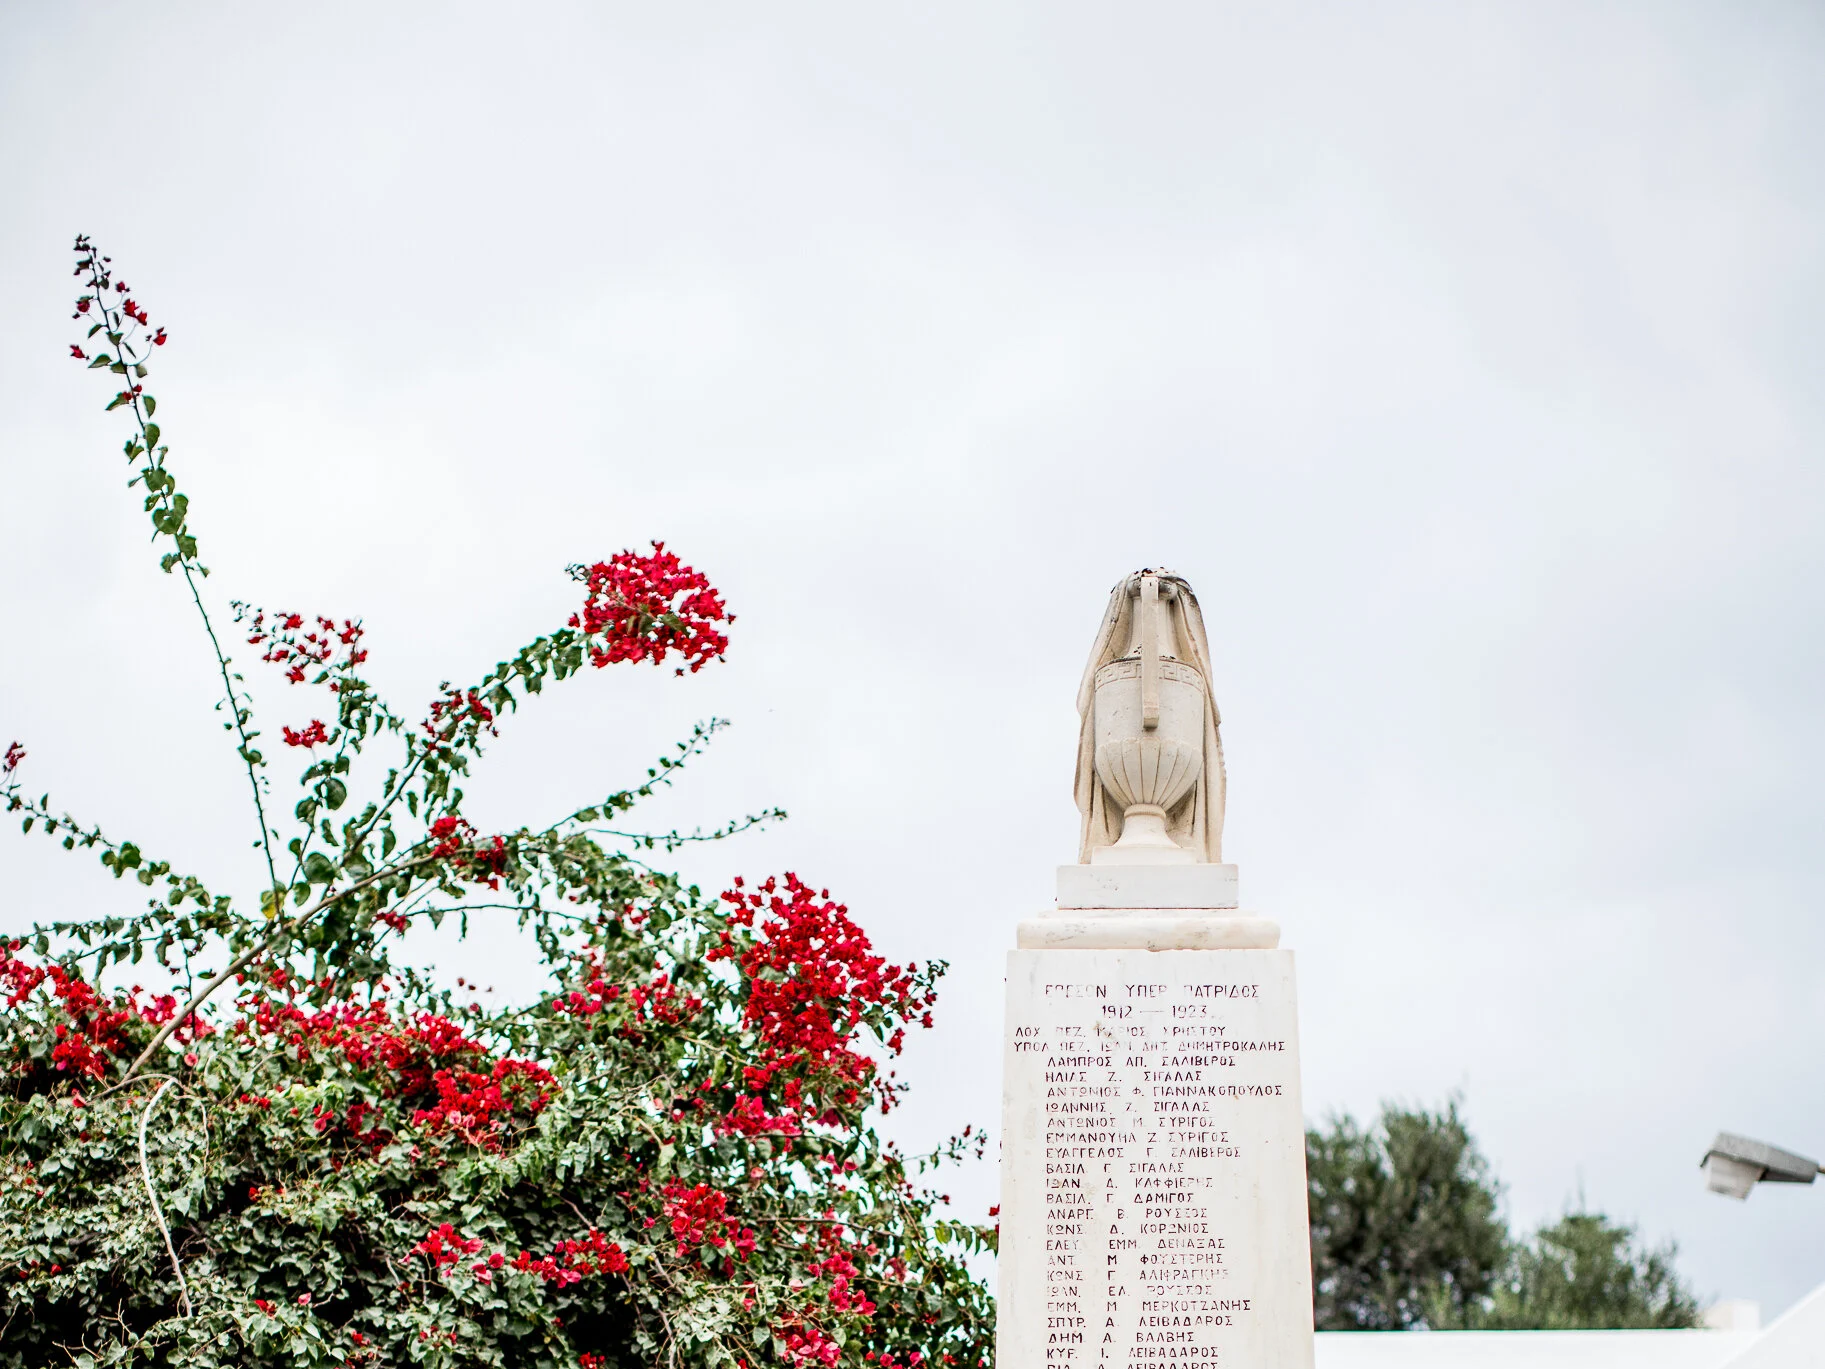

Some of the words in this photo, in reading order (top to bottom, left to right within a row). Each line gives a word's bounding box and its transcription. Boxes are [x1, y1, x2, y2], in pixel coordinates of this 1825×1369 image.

[1125, 985, 1167, 998] ΥΠΕΡ
[1184, 985, 1259, 998] ΠΑΤΡΙΔΟΣ
[1102, 1005, 1132, 1019] 1912
[1179, 1041, 1285, 1051] ΔΗΜΗΤΡΟΚΑΛΗΣ
[1048, 1056, 1112, 1067] ΛΑΜΠΡΟΣ
[1126, 1056, 1147, 1067] ΑΠ.
[1162, 1056, 1235, 1067] ΣΑΛΙΒΕΡΟΣ
[1046, 1072, 1086, 1082] ΗΛΙΑΣ
[1108, 1072, 1122, 1082] Ζ.
[1144, 1071, 1201, 1082] ΣΙΓΑΛΑΣ
[1048, 1087, 1120, 1097] ΑΝΤΩΝΙΟΣ
[1132, 1086, 1144, 1097] Φ.
[1154, 1085, 1282, 1097] ΓΙΑΝΝΑΚΟΠΟΥΛΟΣ
[1126, 1103, 1137, 1111] Ζ.
[1154, 1101, 1209, 1112] ΣΙΓΑΛΑΣ
[1048, 1118, 1115, 1128] ΑΝΤΩΝΙΟΣ
[1159, 1117, 1215, 1127] ΣΥΡΙΓΟΣ
[1047, 1132, 1136, 1144] ΕΜΜΑΝΟΥΗΛ
[1169, 1132, 1228, 1143] ΣΥΡΙΓΟΣ
[1047, 1148, 1124, 1158] ΕΥΑΓΓΕΛΟΣ
[1172, 1147, 1240, 1158] ΣΑΛΙΒΕΡΟΣ
[1129, 1163, 1184, 1173] ΣΙΓΑΛΑΣ
[1106, 1178, 1117, 1188] Δ.
[1047, 1193, 1090, 1204] ΒΑΣΙΛ.
[1134, 1193, 1194, 1203] ΔΑΜΙΓΟΣ
[1146, 1208, 1207, 1218] ΡΟΥΣΣΟΣ
[1110, 1224, 1124, 1235] Δ.
[1141, 1223, 1208, 1234] ΚΟΡΩΝΙΟΣ
[1158, 1239, 1225, 1249] ΔΕΝΑΞΑΣ
[1140, 1254, 1222, 1264] ΦΟΥΣΤΕΡΗΣ
[1048, 1302, 1080, 1313] ΕΜΜ.
[1143, 1300, 1250, 1312] ΜΕΡΚΟΤΖΑΝΗΣ
[1048, 1317, 1086, 1328] ΣΠΥΡ.
[1139, 1316, 1232, 1327] ΛΕΙΒΑΔΑΡΟΣ
[1137, 1332, 1194, 1342] ΒΑΛΒΗΣ
[1129, 1347, 1218, 1358] ΛΕΙΒΑΔΑΡΟΣ
